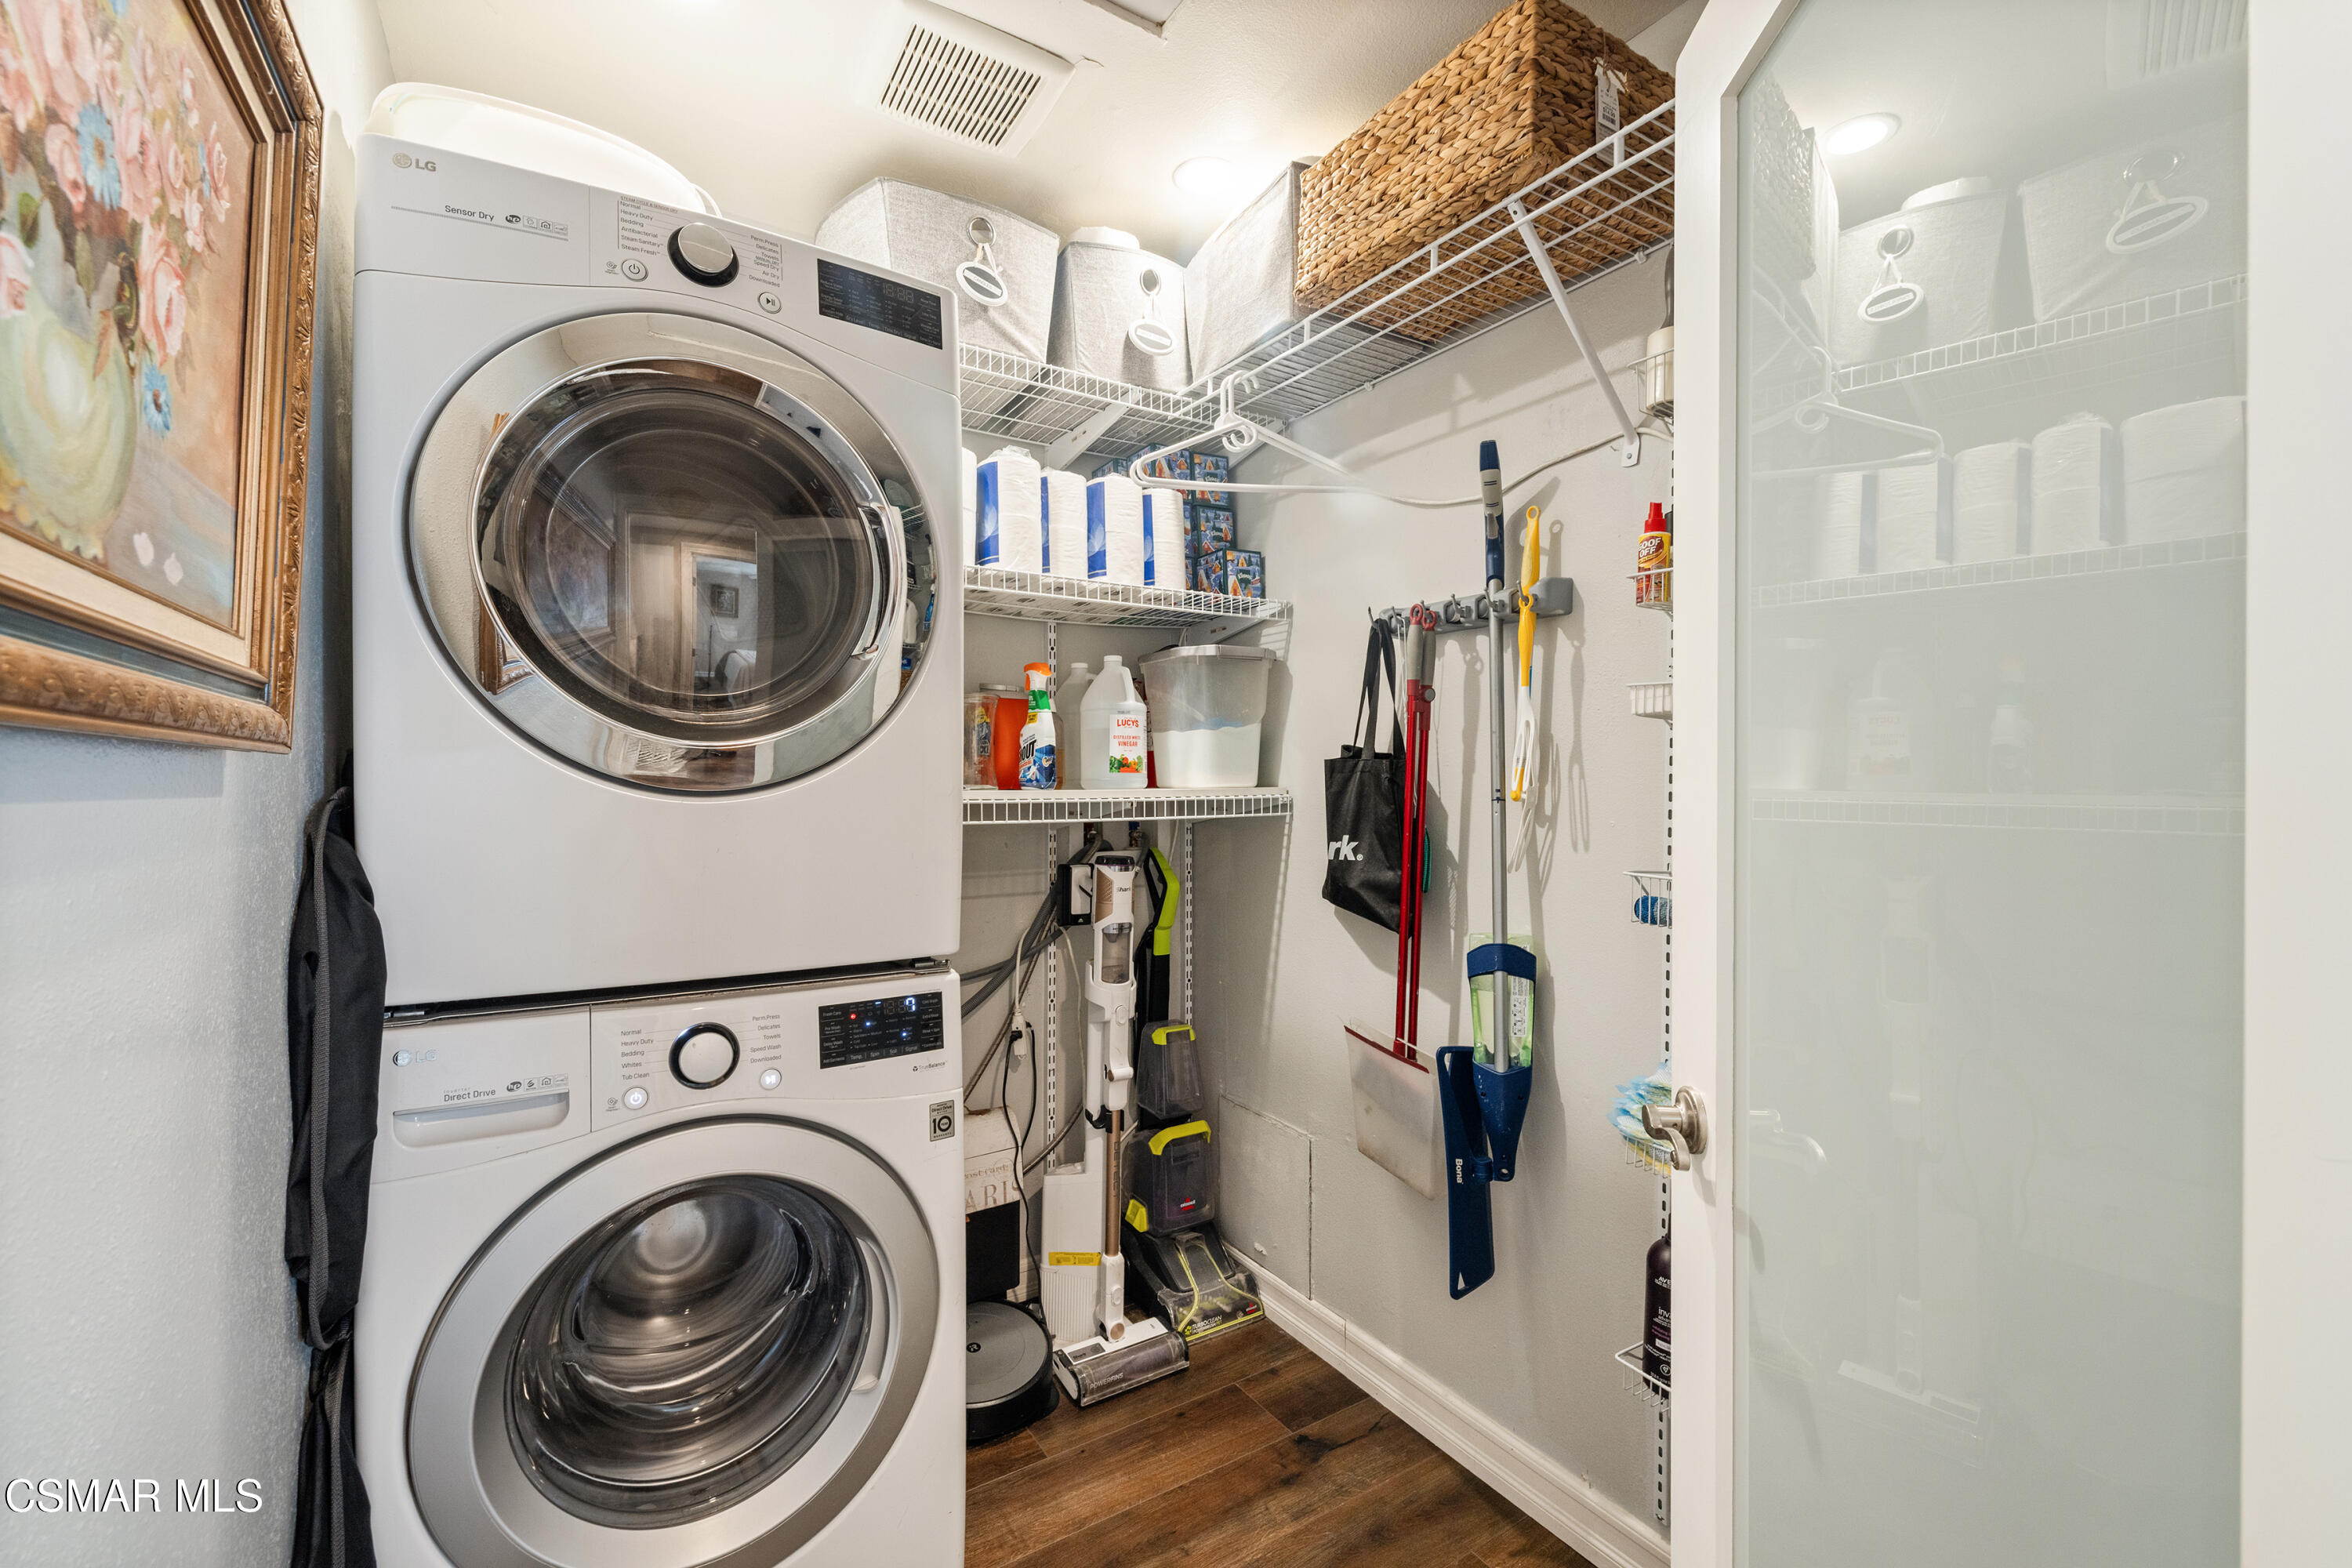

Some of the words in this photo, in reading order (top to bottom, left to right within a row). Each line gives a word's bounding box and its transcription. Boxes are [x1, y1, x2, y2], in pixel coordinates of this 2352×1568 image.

[415, 158, 437, 172] LG
[620, 201, 641, 210] Normal
[445, 205, 477, 218] Sensor
[478, 211, 495, 222] Dry
[620, 209, 639, 218] Heavy
[620, 217, 644, 227] Bedding
[621, 226, 659, 238] Antibacterial
[621, 234, 638, 243] Steam
[621, 244, 641, 252] Steam
[756, 243, 779, 255] Delicates
[761, 252, 779, 262] Towels
[753, 260, 770, 270] Speed
[770, 263, 779, 272] Dry
[749, 274, 781, 289] Downloaded
[770, 271, 780, 280] Dry
[1639, 546, 1656, 558] OFF
[757, 1023, 781, 1032] Delicates
[750, 1045, 767, 1054] Speed
[416, 1049, 438, 1064] LG
[750, 1054, 782, 1064] Downloaded
[444, 1092, 470, 1102] Direct
[473, 1088, 496, 1099] Drive
[931, 1115, 952, 1134] 10
[1090, 1372, 1123, 1389] POWERFINS
